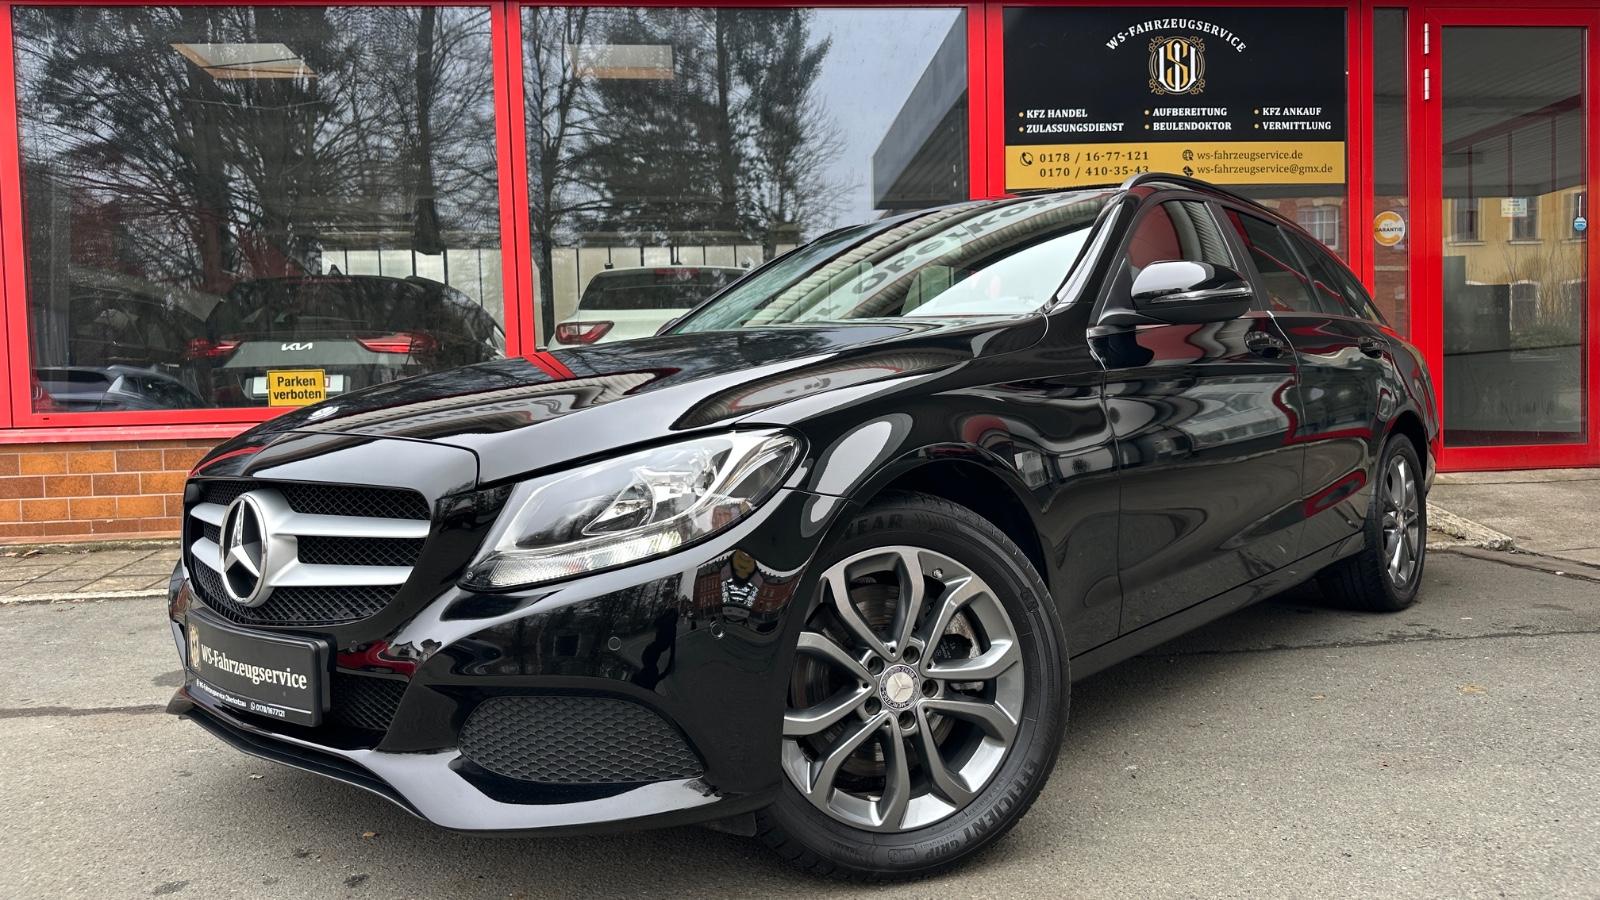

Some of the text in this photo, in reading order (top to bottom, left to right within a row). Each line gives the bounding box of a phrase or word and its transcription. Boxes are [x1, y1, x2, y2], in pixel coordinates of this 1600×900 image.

[1105, 18, 1247, 53] WS-FAHRZEUGSERVICE
[1026, 108, 1088, 119] KFZ HANDEL
[1152, 107, 1228, 117] AUFBEREITUNG
[1262, 107, 1322, 116] KFZ ANKAUF
[1026, 123, 1124, 134] ZULASSUNGSDIENST
[1153, 122, 1232, 131] BEULENDOKTOR
[1262, 121, 1332, 130] VERMITTLUNG
[1039, 152, 1070, 163] 0178
[1086, 151, 1149, 162] 16-77-121
[1196, 150, 1303, 162] ws-fahrzeugservice.de
[1039, 168, 1070, 178] 0170
[1085, 165, 1149, 176] 410-35-43
[1196, 163, 1333, 175] ws-fahrzeugservice@gmx.de
[277, 376, 316, 388] Parken
[273, 389, 322, 400] verboten
[201, 643, 308, 690] WS-Fahrzeugservice
[963, 760, 1041, 841] EFFICIENT
[924, 840, 960, 860] GRIP
